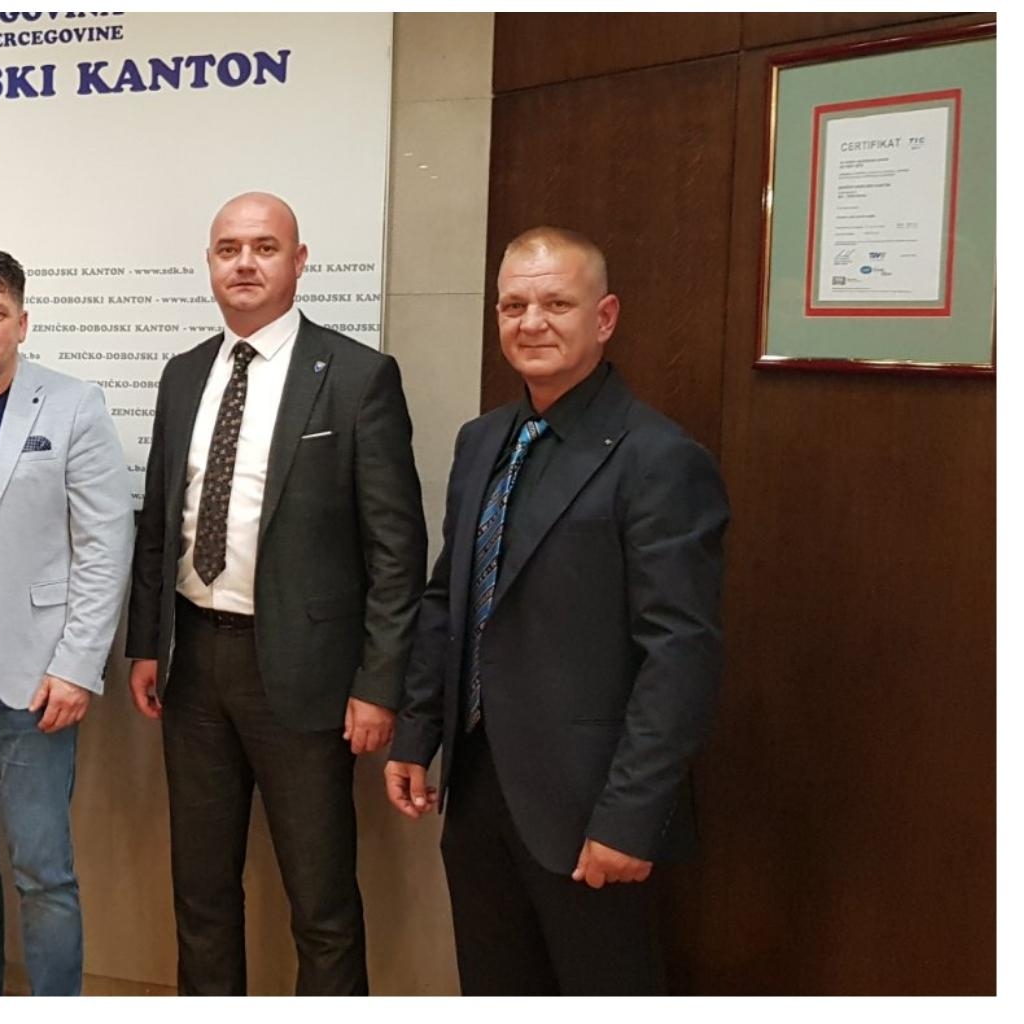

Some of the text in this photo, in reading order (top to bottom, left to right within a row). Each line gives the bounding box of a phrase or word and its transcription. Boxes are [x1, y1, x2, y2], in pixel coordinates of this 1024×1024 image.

[76, 50, 291, 95] KANTON
[840, 137, 901, 152] CERTIFIKAT
[81, 267, 126, 276] KANTON
[134, 266, 195, 275] www.zdk.ba
[326, 262, 376, 273] KANTON
[108, 296, 152, 304] KANTON
[32, 323, 131, 333] ZENIČKO-DOBOJSKI
[134, 324, 180, 333] KANTON
[58, 351, 158, 361] ZENIČKO-DOBOJSKI
